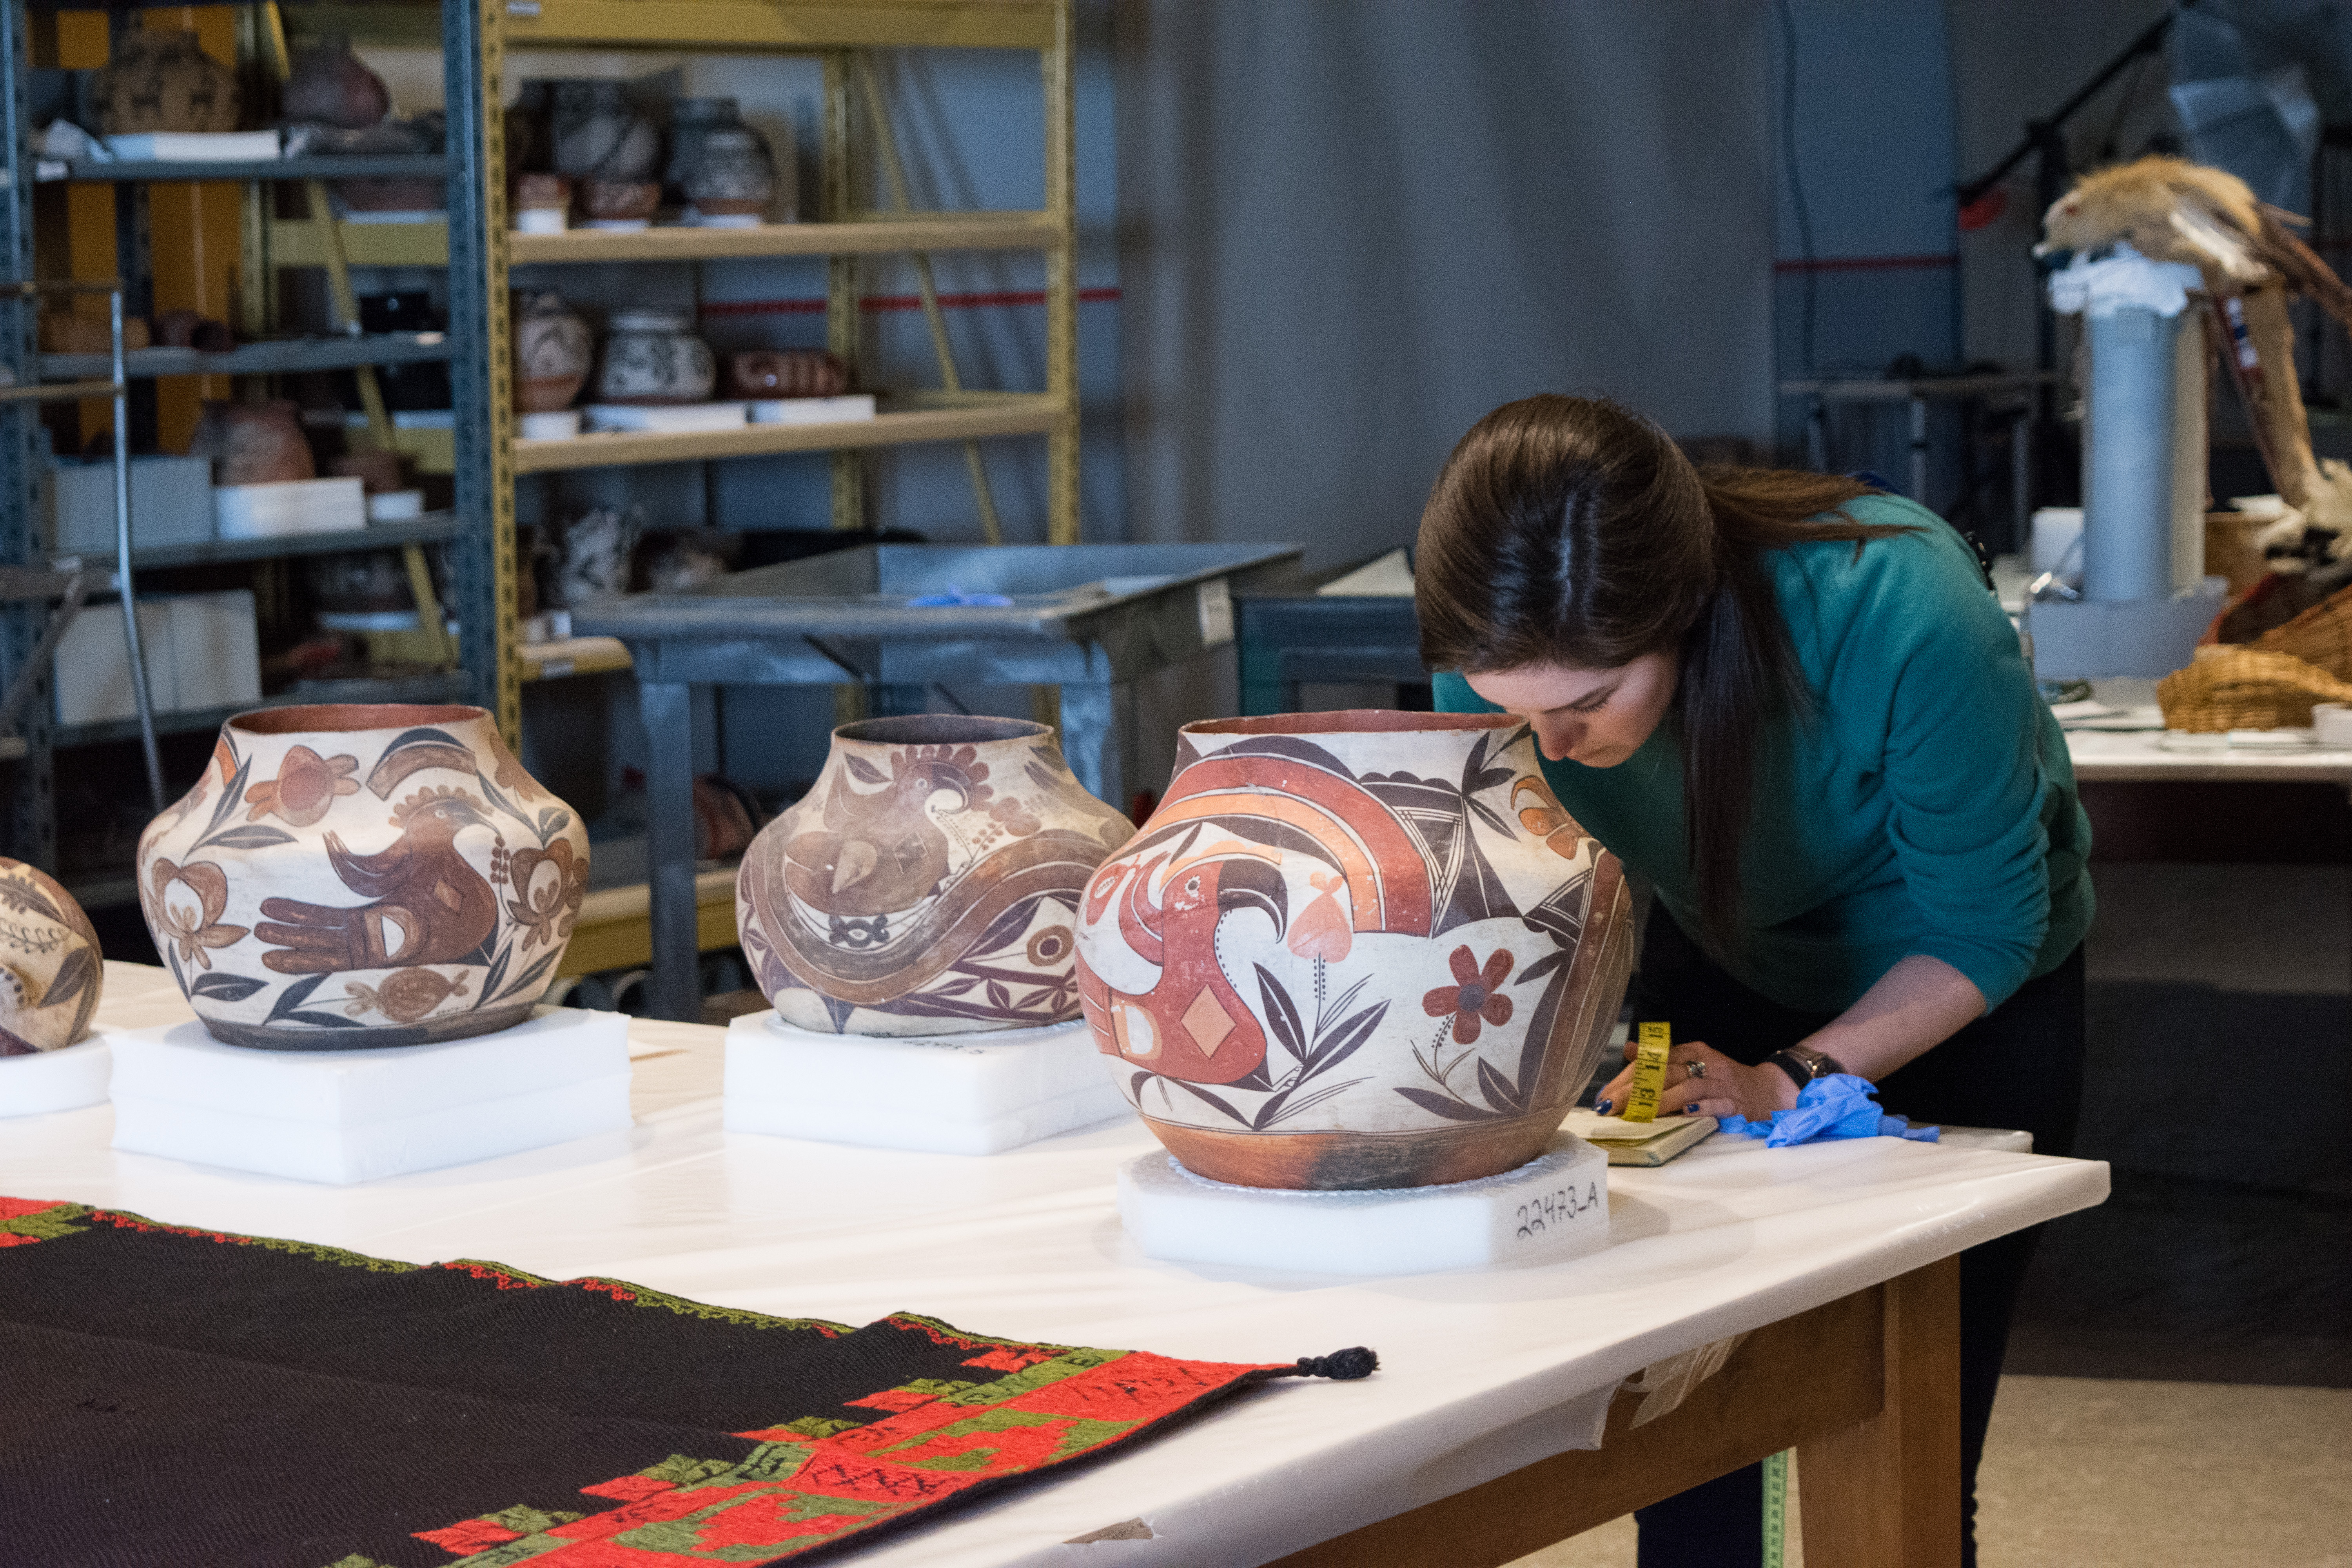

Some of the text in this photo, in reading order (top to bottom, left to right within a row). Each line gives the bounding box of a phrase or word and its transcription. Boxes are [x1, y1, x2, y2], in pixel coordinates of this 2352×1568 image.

[1639, 1026, 1663, 1107] 13 14 15
[1517, 1181, 1599, 1239] 22473_A
